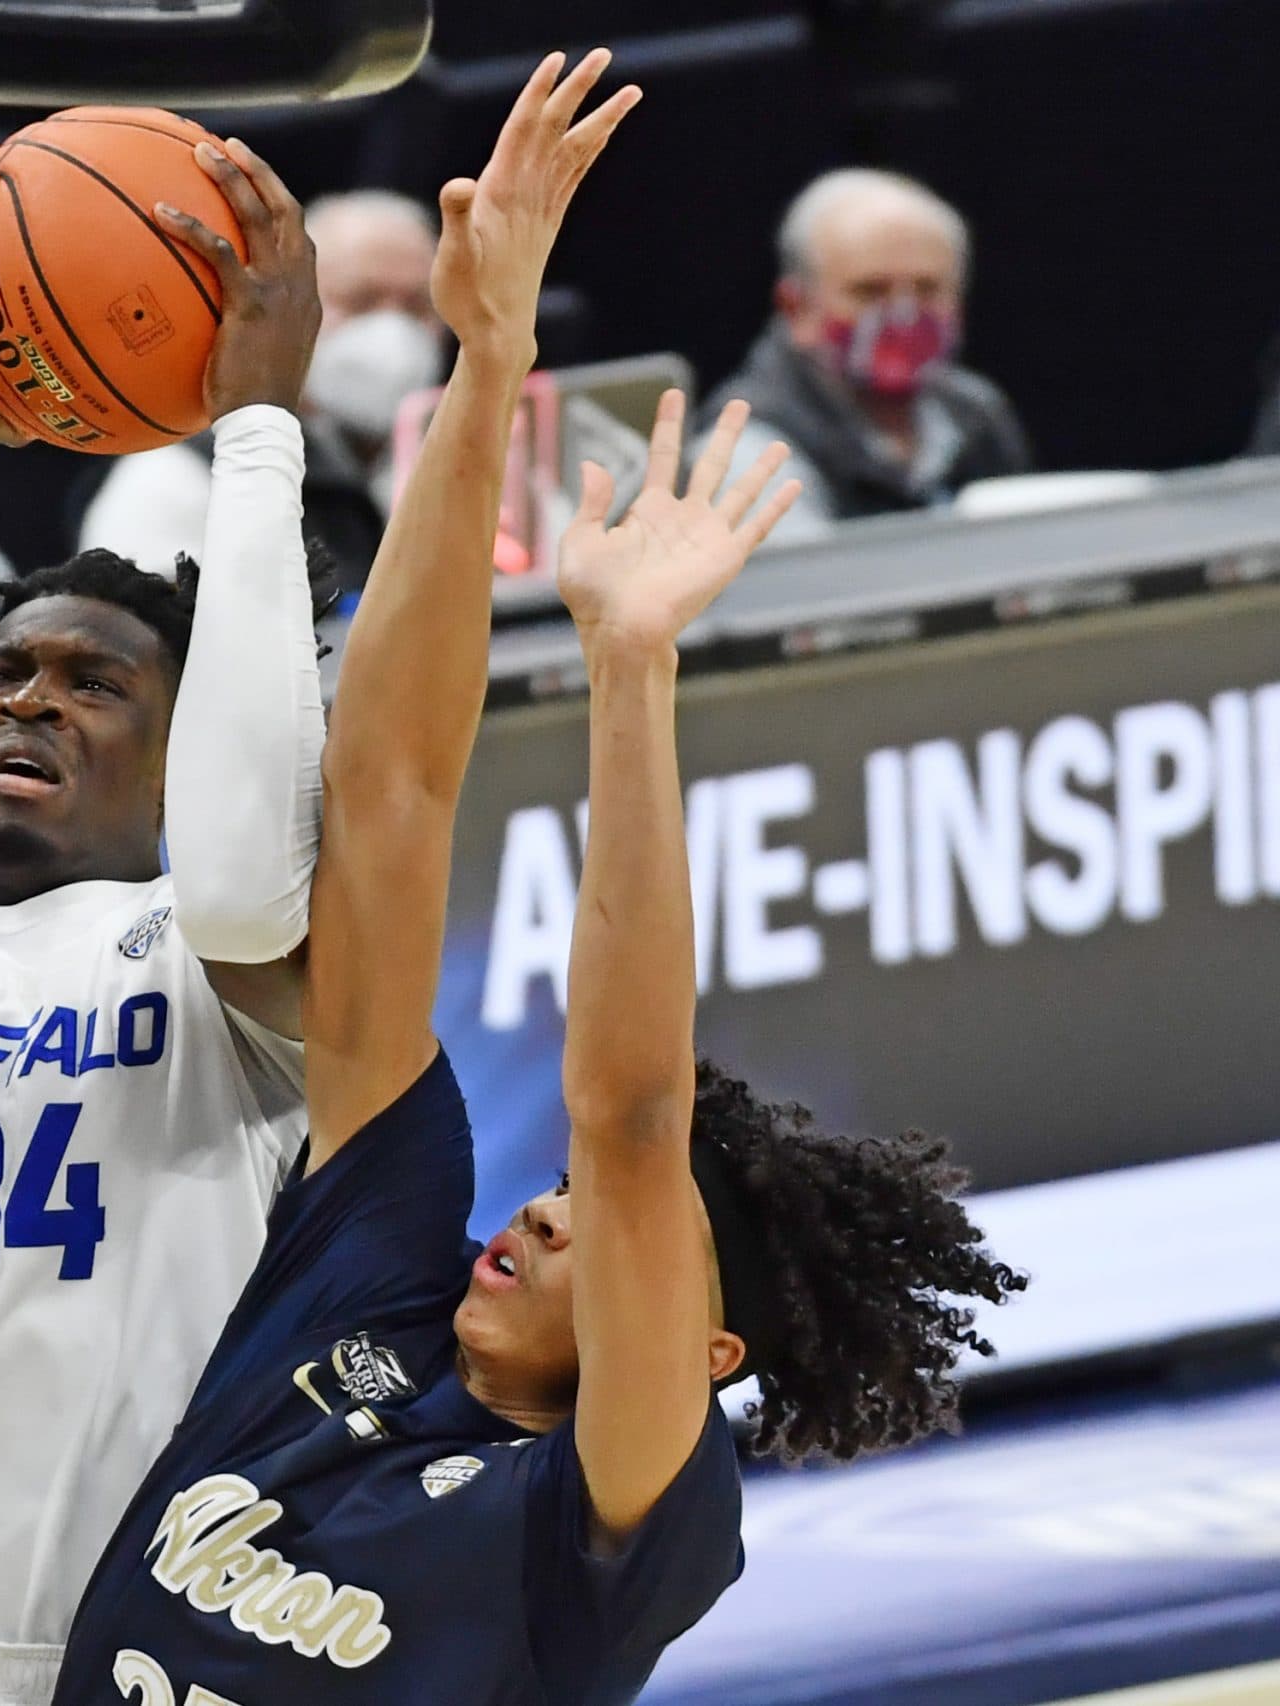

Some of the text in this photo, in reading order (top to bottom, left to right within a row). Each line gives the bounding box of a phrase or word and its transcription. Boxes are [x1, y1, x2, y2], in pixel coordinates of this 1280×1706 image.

[16, 334, 74, 402] LEGACY
[18, 285, 109, 414] DEEP CHANNEL DESIGN
[480, 683, 1280, 1031] AE-INSPI
[342, 1342, 384, 1401] AKRO
[144, 1473, 392, 1668] Akron
